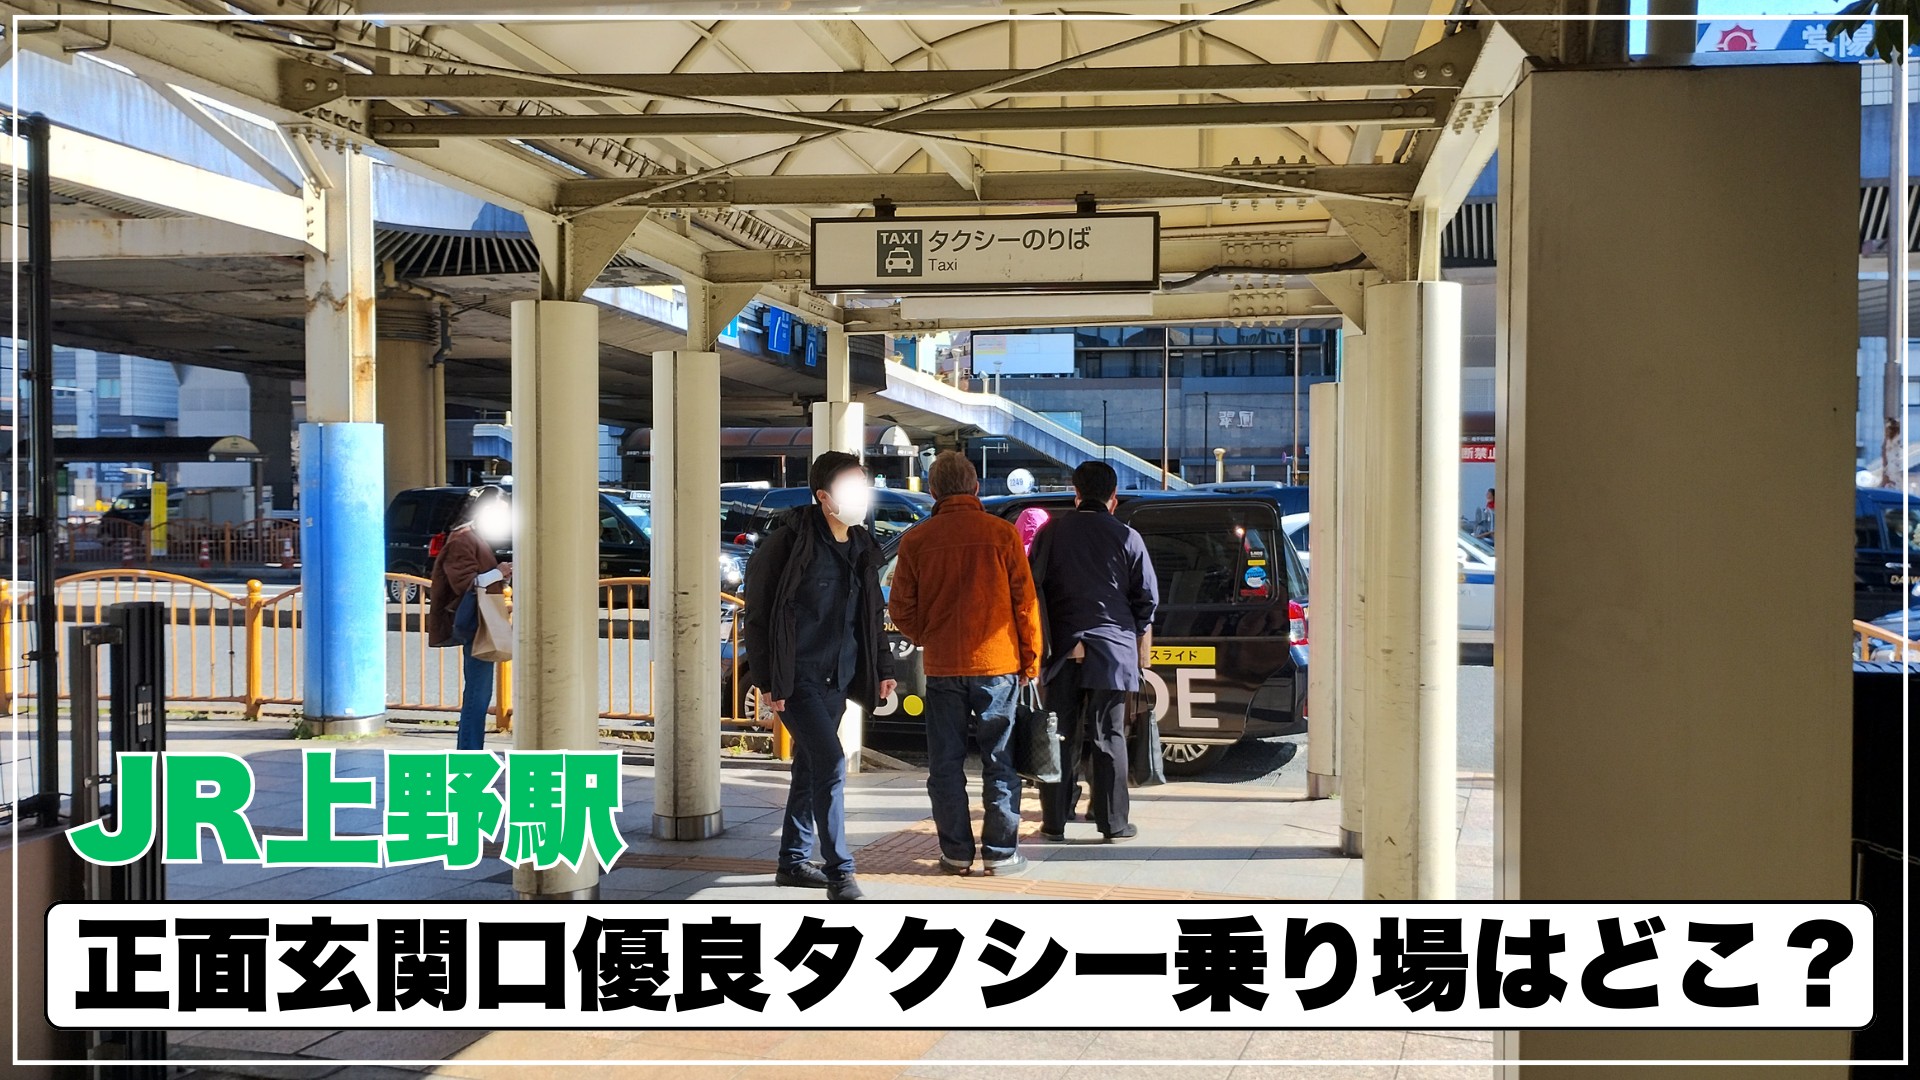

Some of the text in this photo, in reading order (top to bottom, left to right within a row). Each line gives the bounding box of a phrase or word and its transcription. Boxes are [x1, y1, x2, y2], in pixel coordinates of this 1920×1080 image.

[880, 232, 918, 245] TAXI
[928, 226, 1092, 253] タクシーのりば
[928, 258, 958, 272] Taxi
